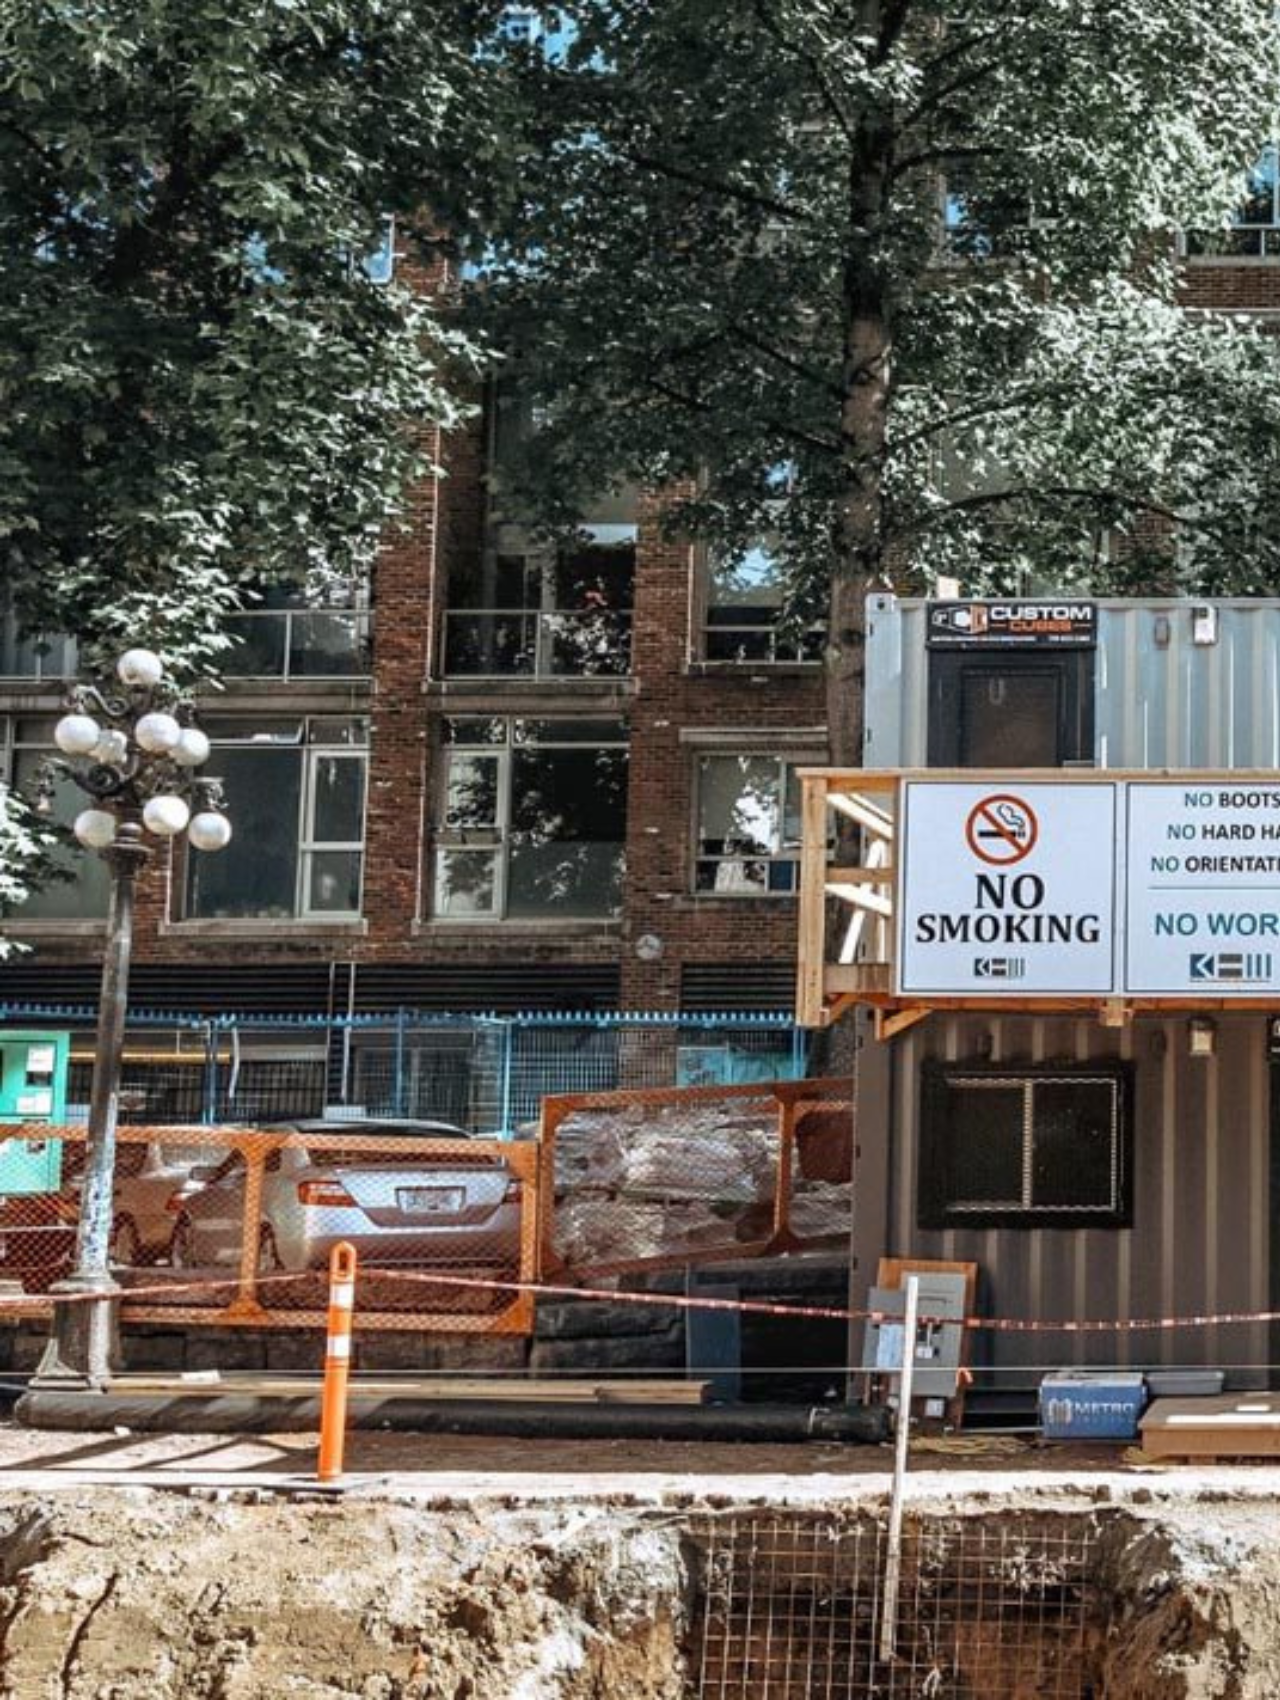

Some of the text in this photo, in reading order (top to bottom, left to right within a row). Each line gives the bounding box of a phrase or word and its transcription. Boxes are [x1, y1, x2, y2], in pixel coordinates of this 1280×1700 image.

[990, 606, 1091, 620] CUSTOM
[1184, 793, 1214, 808] NO
[1167, 824, 1196, 840] NO
[1202, 824, 1256, 840] HARD
[1151, 856, 1180, 872] NO
[975, 874, 1045, 910] NO
[916, 914, 1100, 943] SMOKING
[1154, 913, 1198, 936] NO
